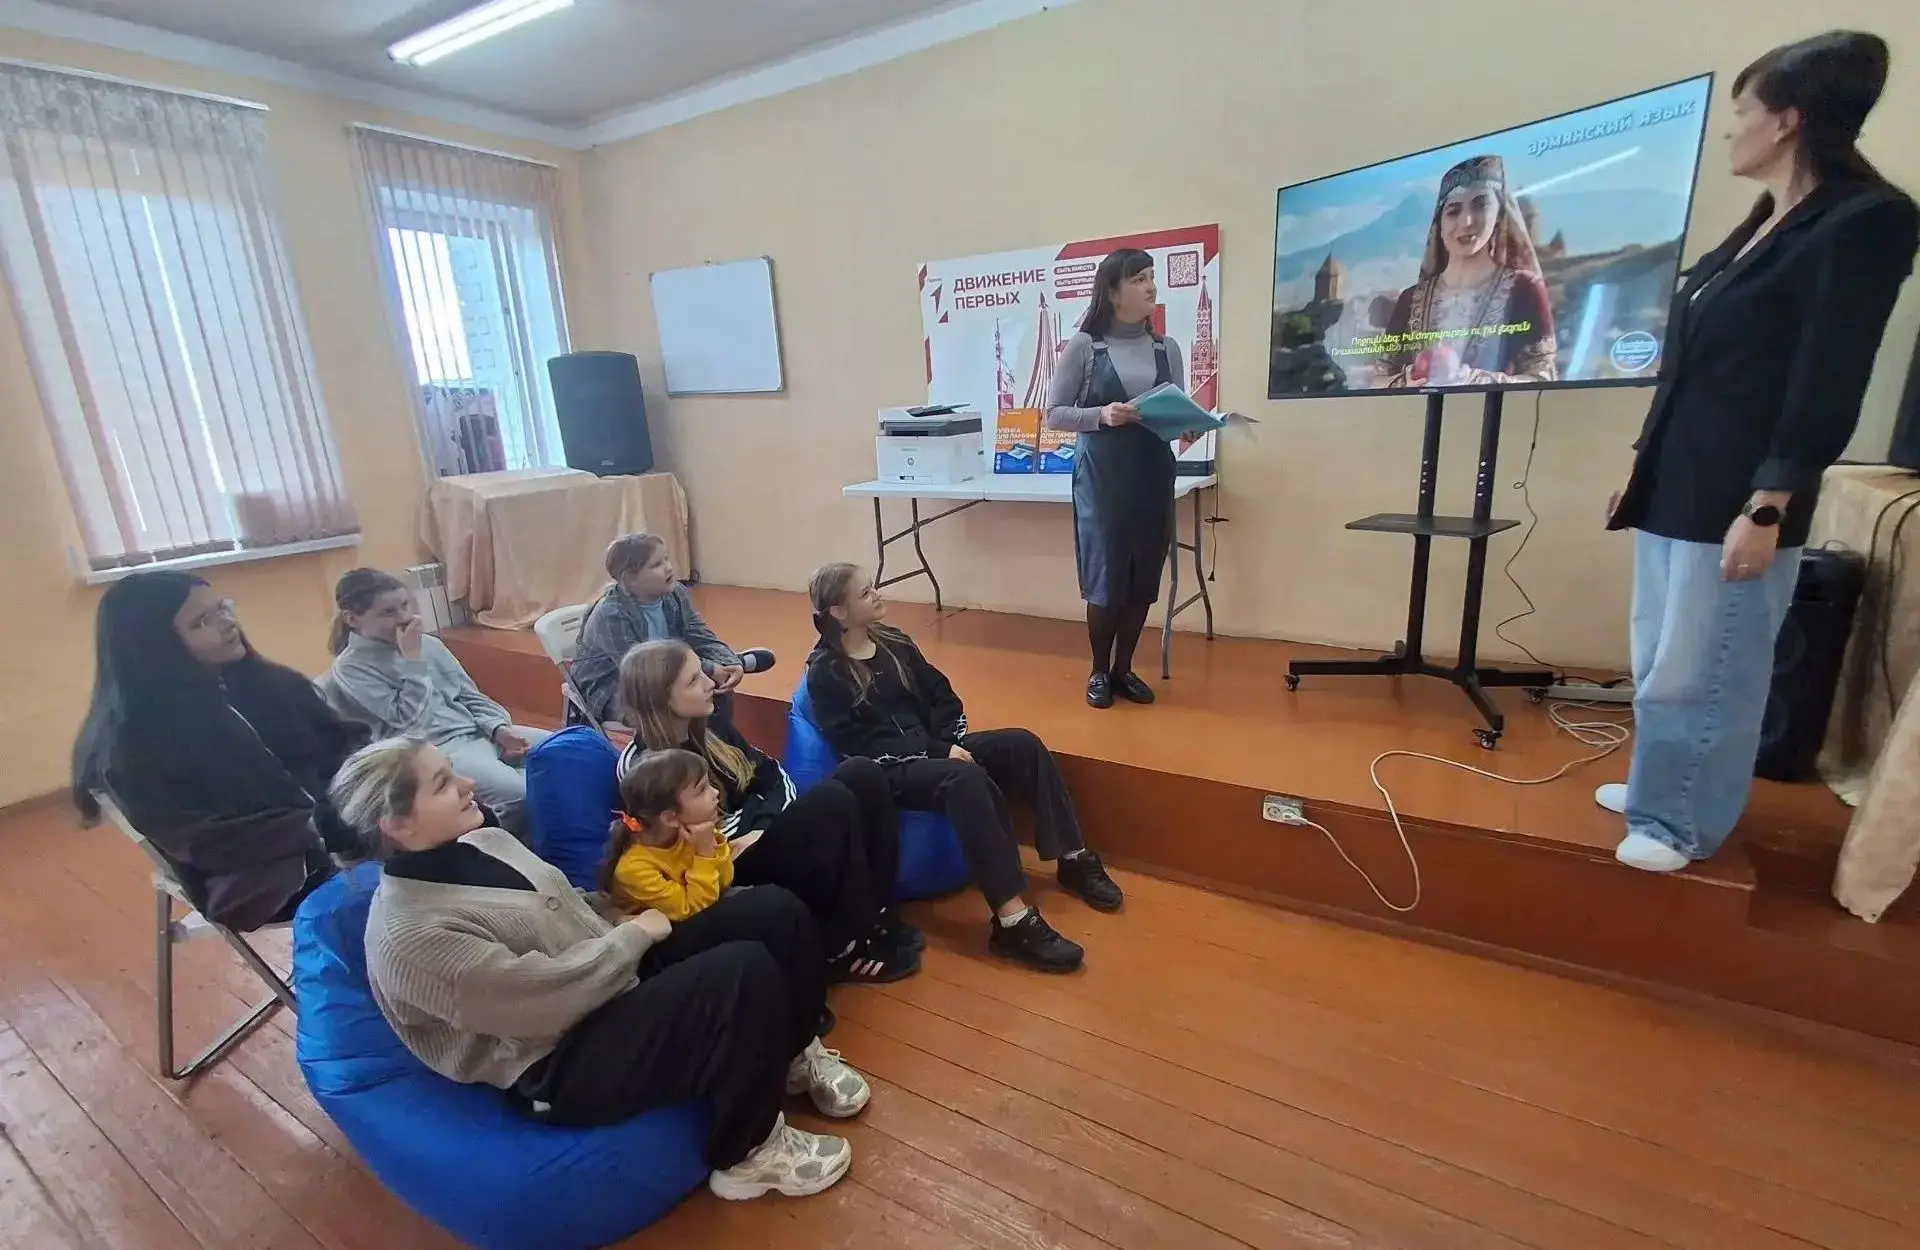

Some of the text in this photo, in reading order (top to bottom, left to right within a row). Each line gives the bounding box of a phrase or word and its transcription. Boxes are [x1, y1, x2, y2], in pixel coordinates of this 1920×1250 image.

[1527, 98, 1698, 158] армянский язык
[953, 268, 1047, 294] ДВИЖЕНИЕ
[955, 290, 1021, 311] ПЕРВЫХ
